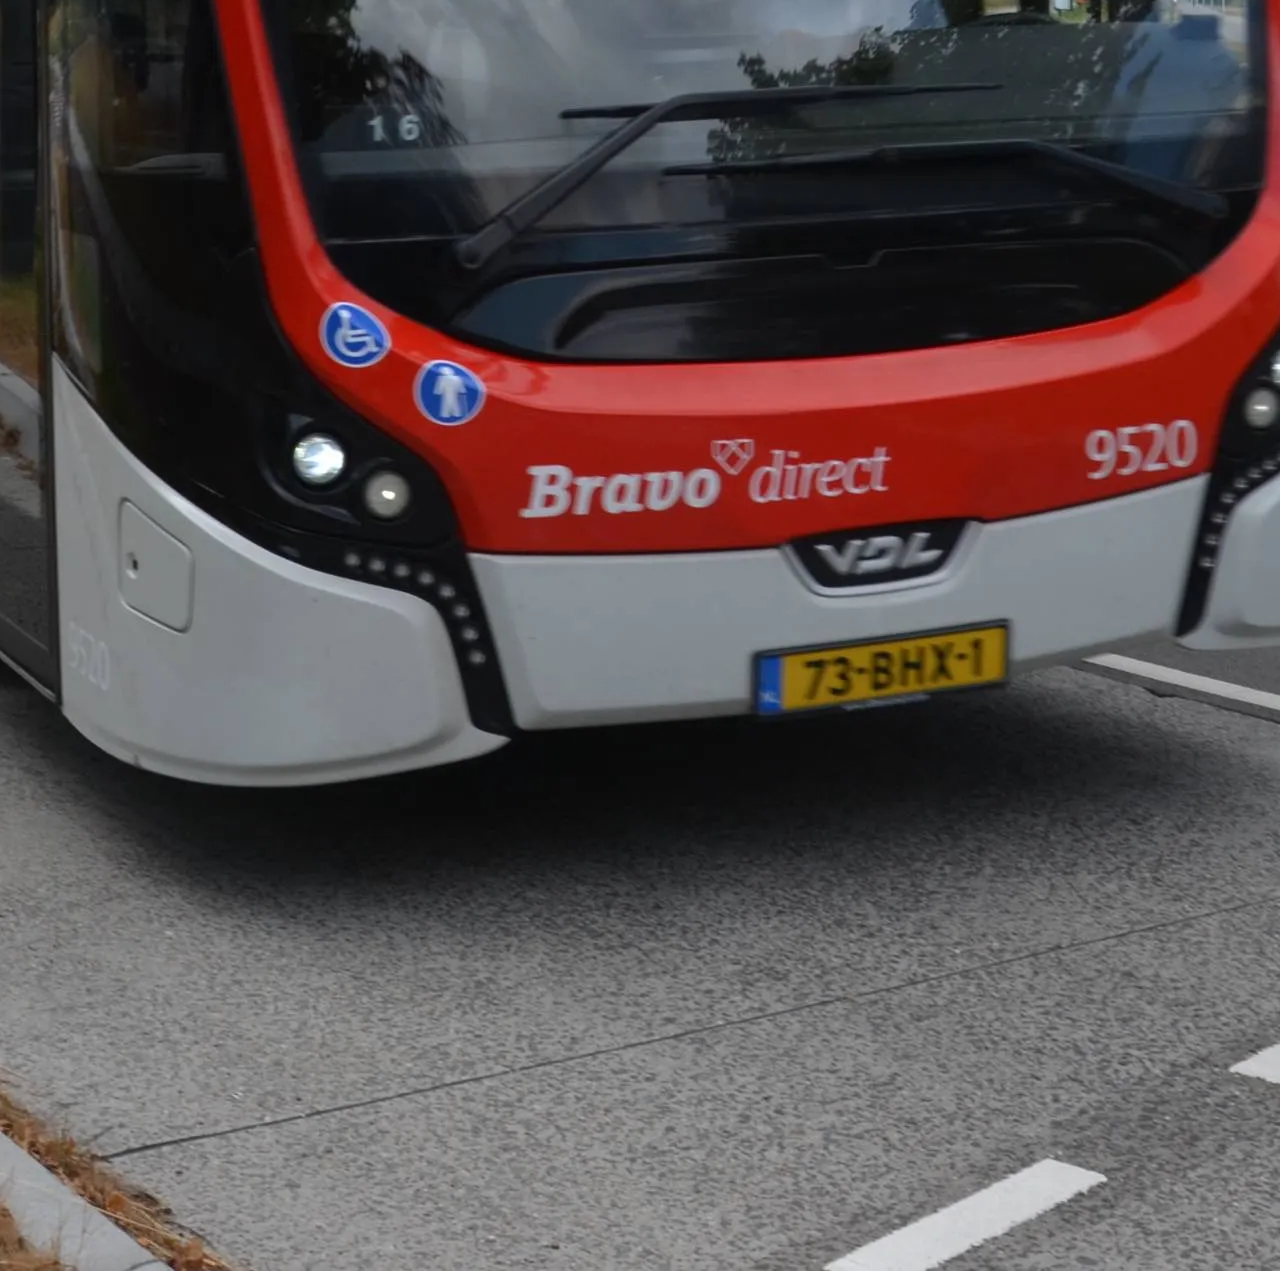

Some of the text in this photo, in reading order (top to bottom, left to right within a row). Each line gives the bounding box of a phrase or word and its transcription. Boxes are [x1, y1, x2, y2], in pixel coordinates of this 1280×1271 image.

[1084, 419, 1198, 480] 9520
[519, 446, 891, 518] Bravo direct
[814, 531, 943, 575] VDL
[802, 638, 985, 702] 73-BHX-1
